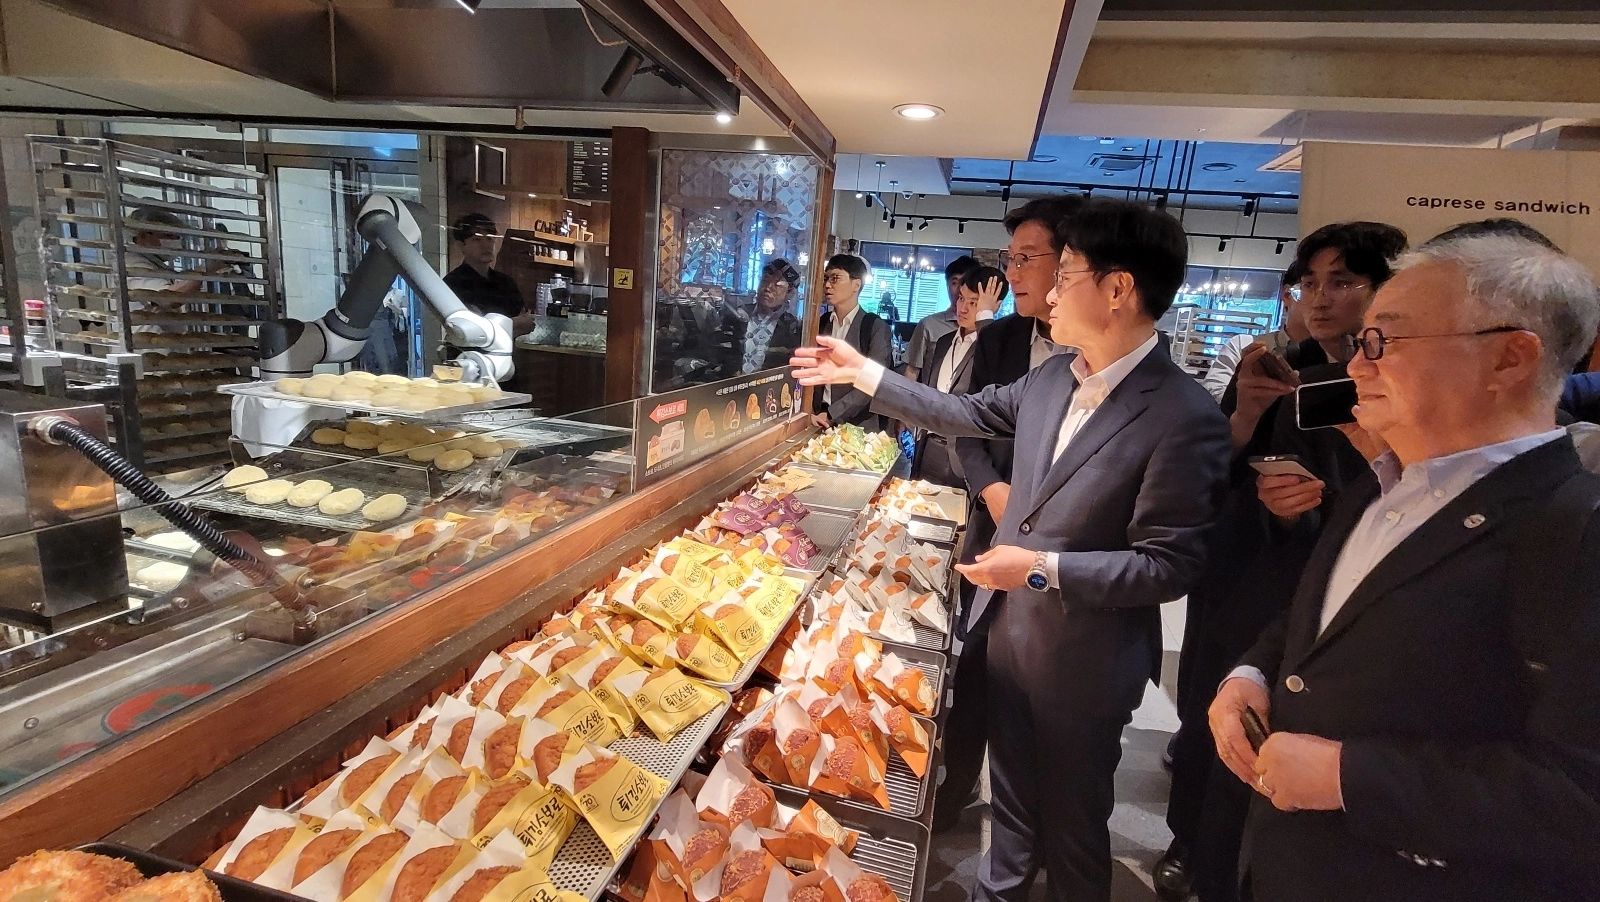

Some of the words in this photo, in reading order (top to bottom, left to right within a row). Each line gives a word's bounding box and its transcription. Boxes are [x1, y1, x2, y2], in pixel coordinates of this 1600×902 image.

[1406, 196, 1486, 210] caprese
[1494, 200, 1590, 215] sandwich
[664, 683, 698, 707] 튀김소보로
[582, 797, 593, 807] 70
[517, 796, 565, 848] 튀김소보로
